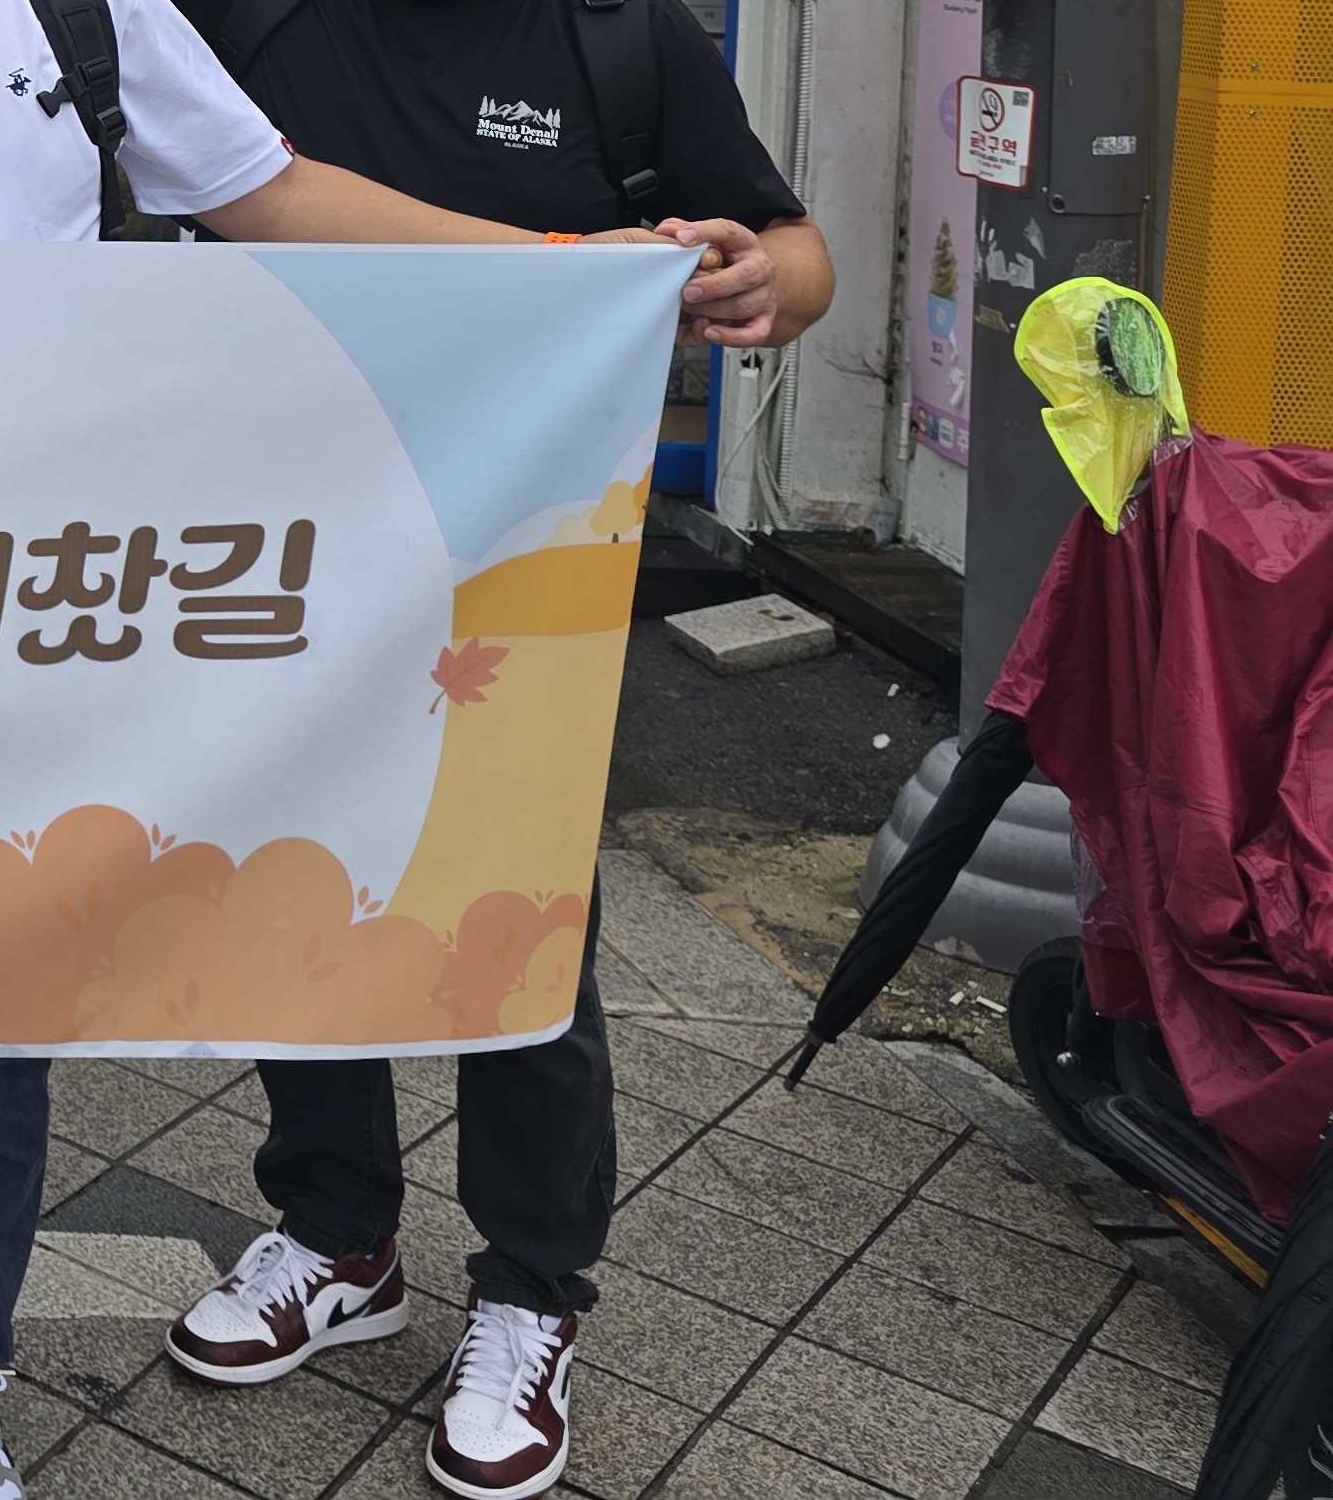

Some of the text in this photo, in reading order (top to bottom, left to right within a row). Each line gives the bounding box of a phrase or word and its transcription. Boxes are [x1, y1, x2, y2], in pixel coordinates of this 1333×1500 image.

[478, 118, 518, 133] Mount
[476, 129, 558, 148] STATE OF ALASKA
